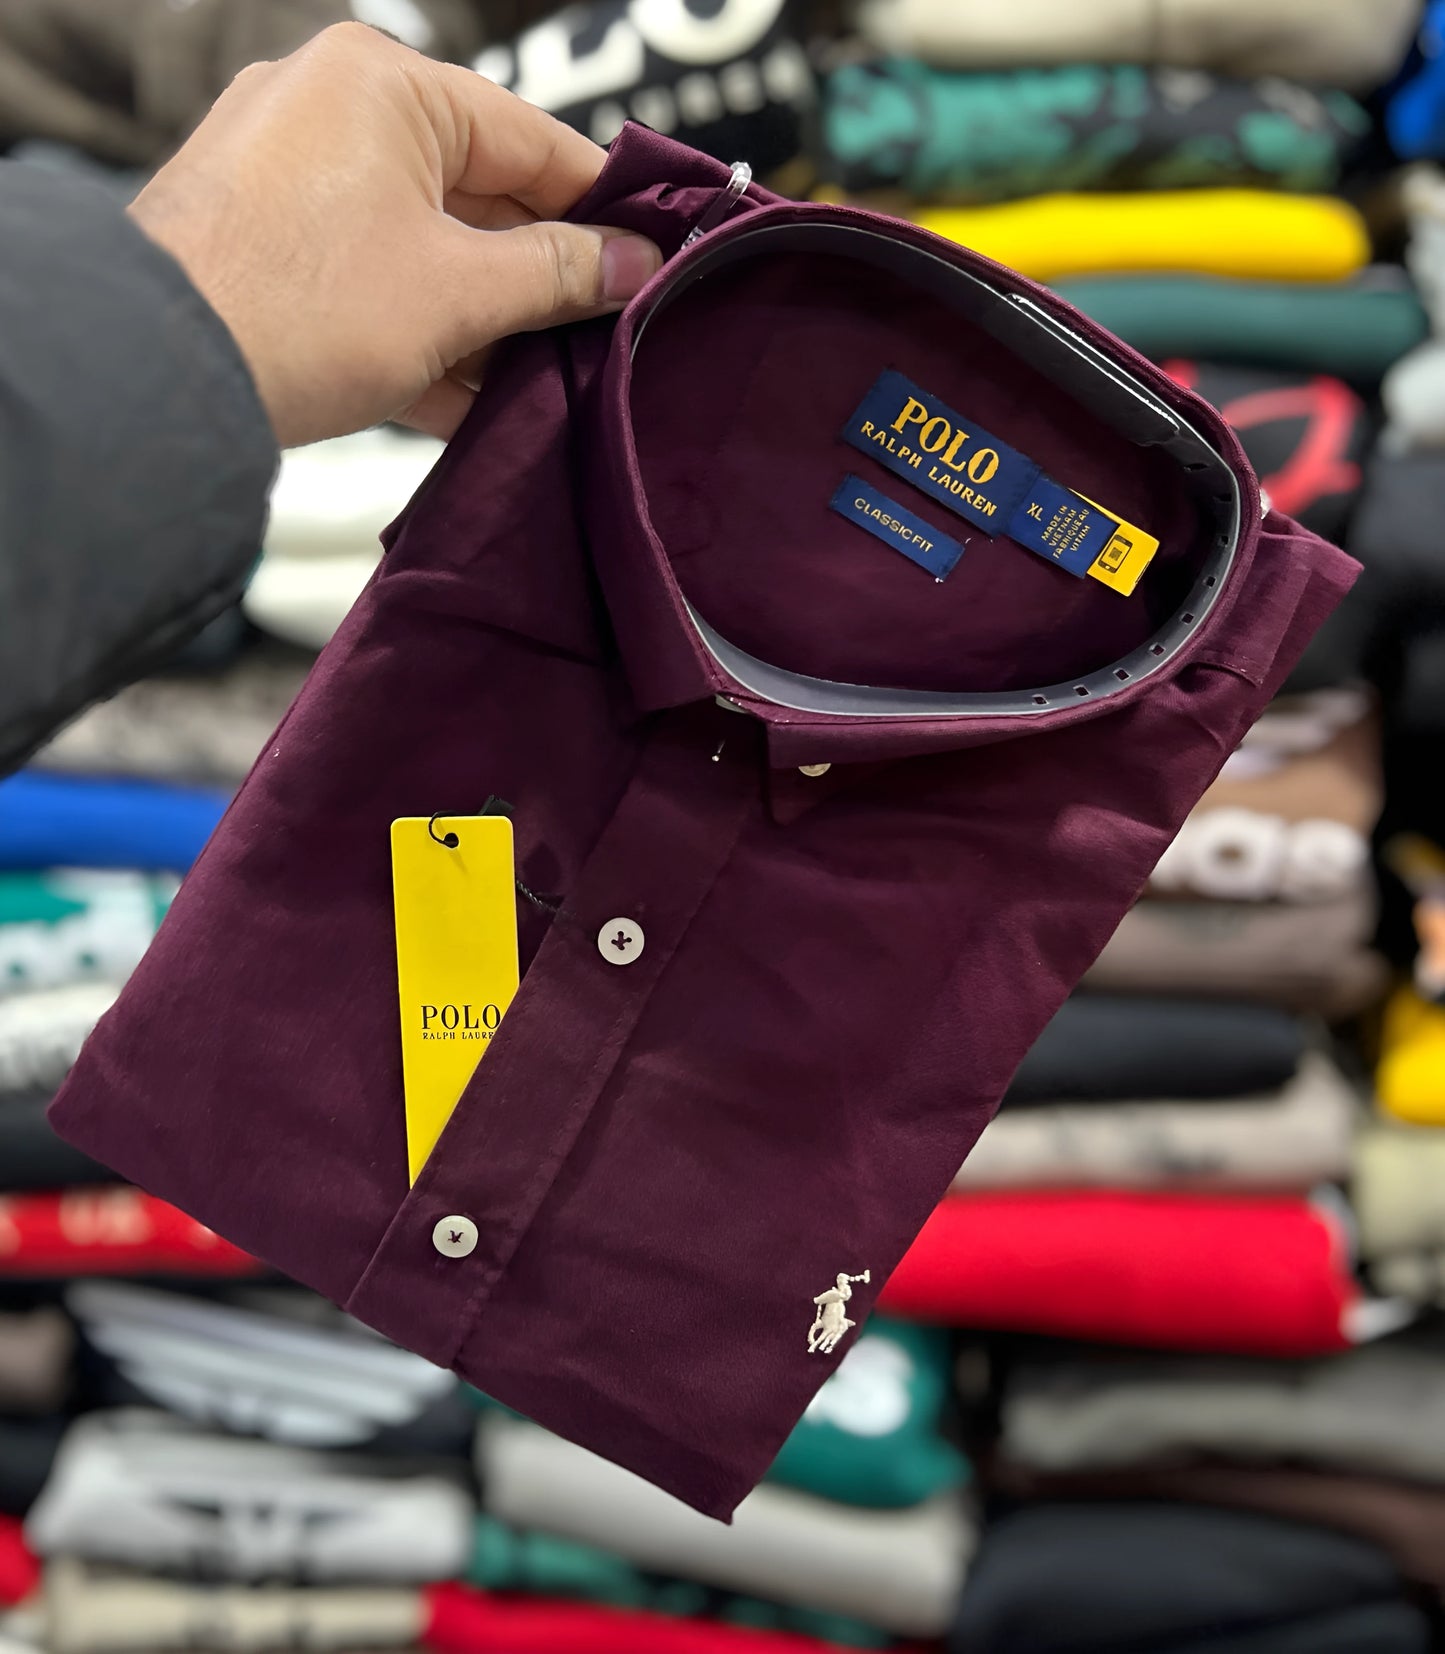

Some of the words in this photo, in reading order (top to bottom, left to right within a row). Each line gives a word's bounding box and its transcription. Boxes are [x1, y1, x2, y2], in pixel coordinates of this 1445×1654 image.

[891, 396, 999, 484] POLO
[861, 421, 923, 469] RALPH
[928, 466, 997, 516] LAUREN
[854, 498, 913, 540] CLASSIC
[911, 534, 934, 552] FIT
[1026, 502, 1043, 521] XL
[1041, 515, 1061, 541] MADE
[1058, 505, 1068, 515] IN
[1049, 509, 1077, 546] VIETNAM
[421, 1004, 501, 1030] POLO
[422, 1032, 456, 1040] RALPH
[461, 1032, 495, 1040] LAURE
